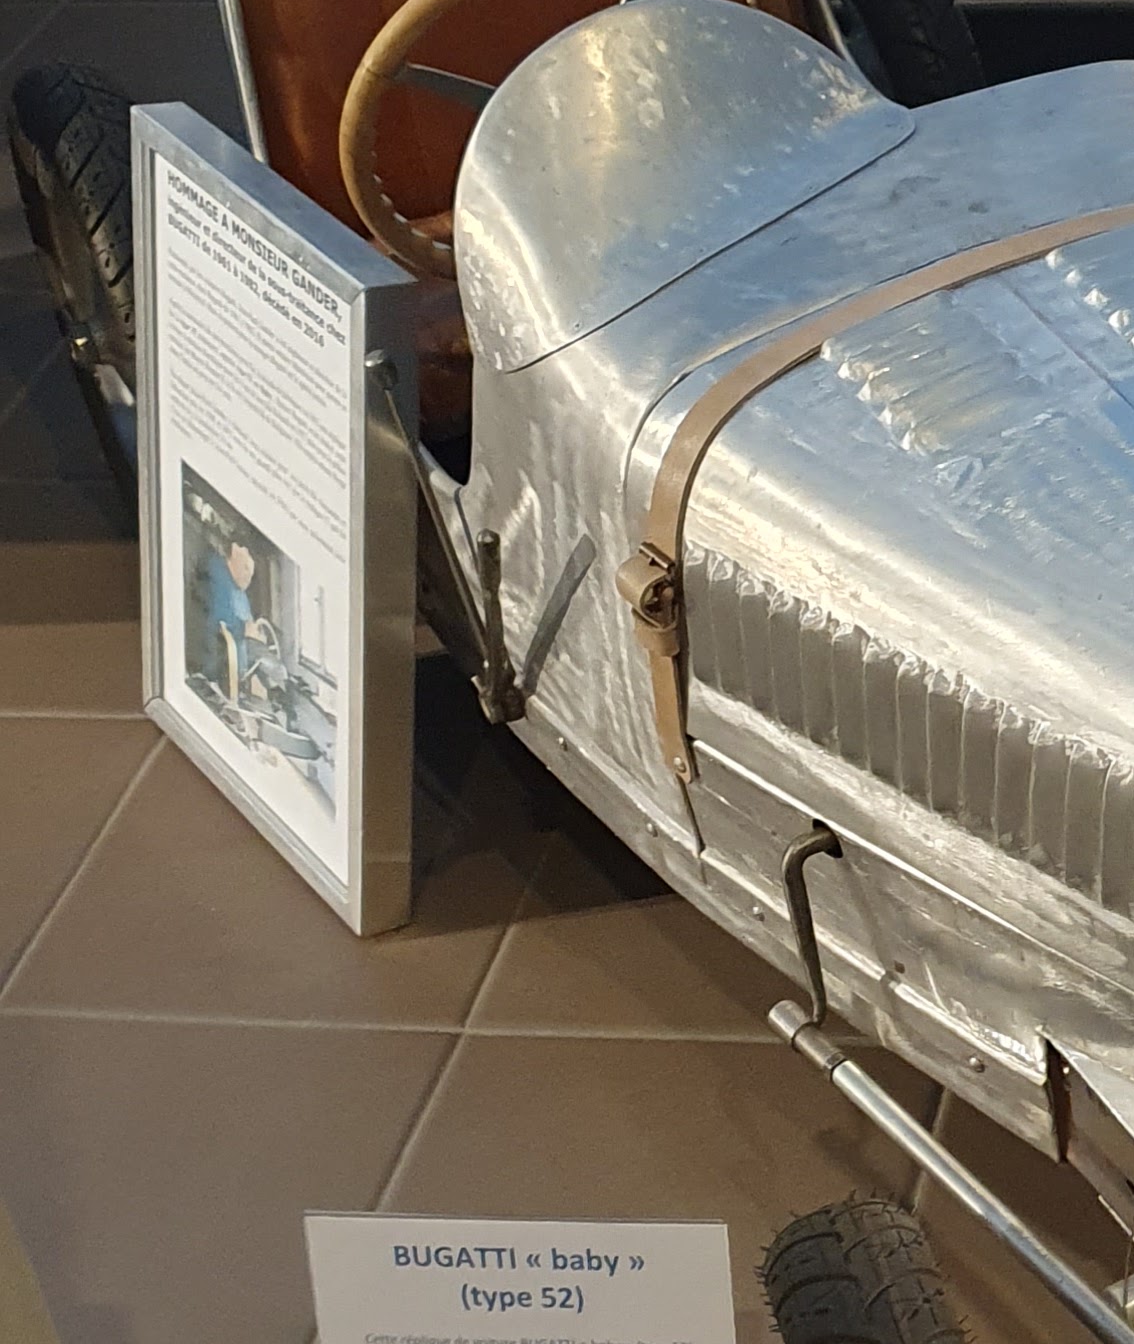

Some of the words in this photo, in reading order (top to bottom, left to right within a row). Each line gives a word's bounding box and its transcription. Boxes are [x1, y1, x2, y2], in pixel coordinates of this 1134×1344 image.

[167, 170, 219, 223] HOMMAGE
[221, 213, 229, 231] A
[232, 220, 289, 279] MONSIEUR
[292, 269, 343, 323] GANDER,
[168, 212, 200, 247] BUGATTI
[201, 241, 211, 257] de
[291, 316, 302, 330] en
[203, 225, 211, 237] et
[212, 231, 247, 264] directeur
[248, 259, 257, 275] de
[258, 266, 267, 282] la
[267, 276, 325, 328] sous-traitance
[326, 323, 346, 346] chez
[393, 1245, 517, 1270] BUGATTI
[526, 1254, 542, 1269] «
[551, 1248, 619, 1277] baby
[629, 1255, 645, 1271] »
[461, 1283, 533, 1312] (type
[541, 1285, 585, 1313] 52)
[365, 1333, 398, 1344] Cette
